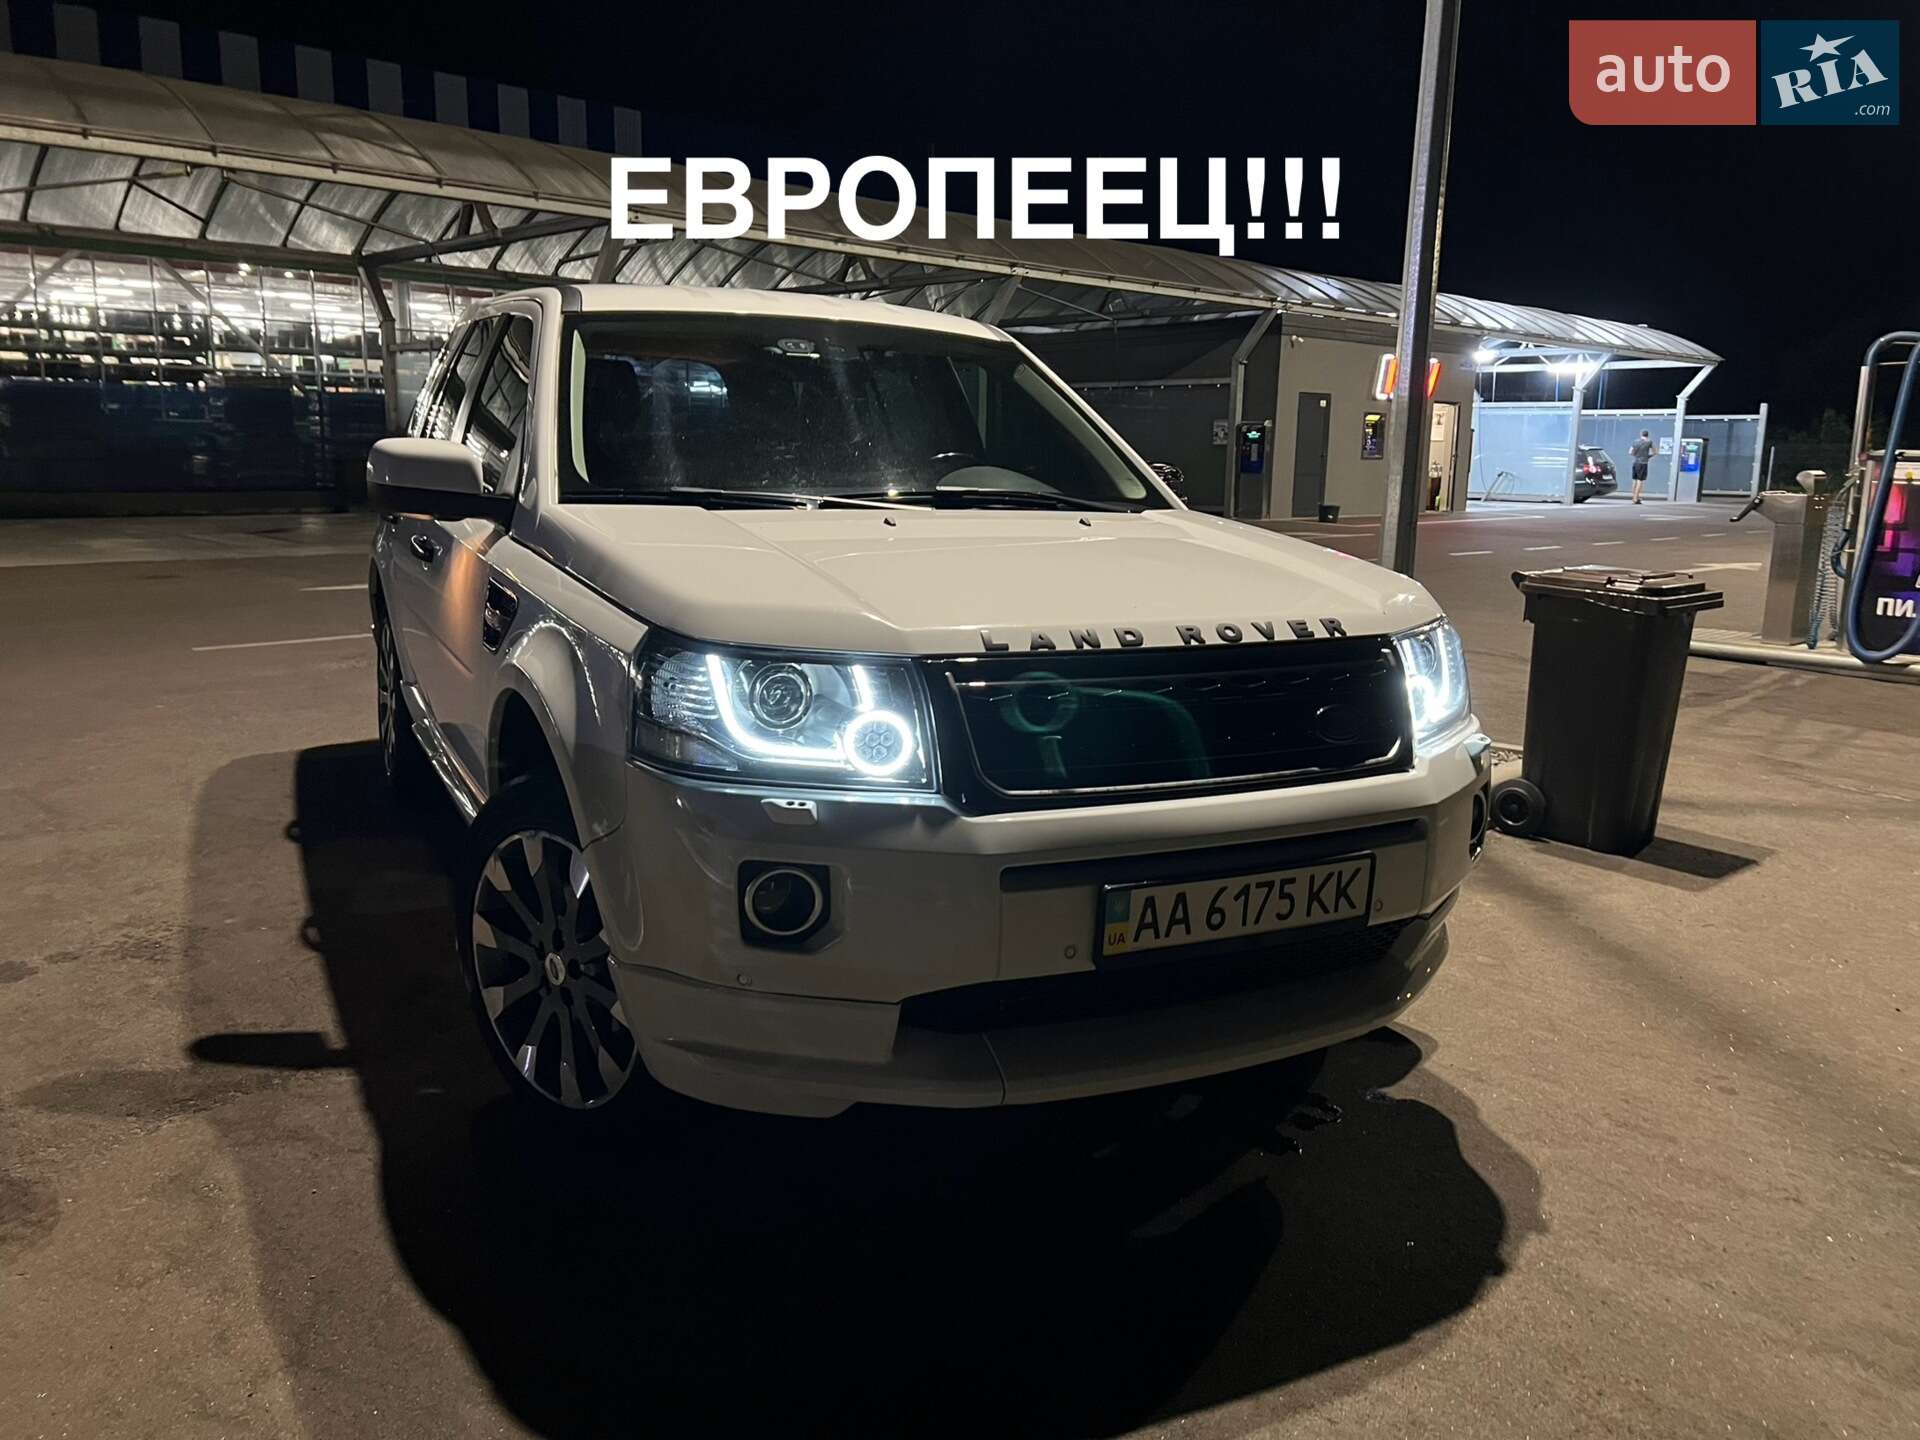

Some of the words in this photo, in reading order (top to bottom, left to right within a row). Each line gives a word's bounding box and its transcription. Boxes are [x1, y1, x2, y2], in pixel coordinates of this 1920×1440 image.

[1876, 597, 1918, 618] ПИ
[980, 627, 1145, 653] LAND
[1175, 617, 1348, 646] ROVER
[1133, 891, 1192, 943] AA
[1205, 877, 1297, 932] 6175
[1306, 867, 1363, 918] KK
[1107, 931, 1127, 946] UA
